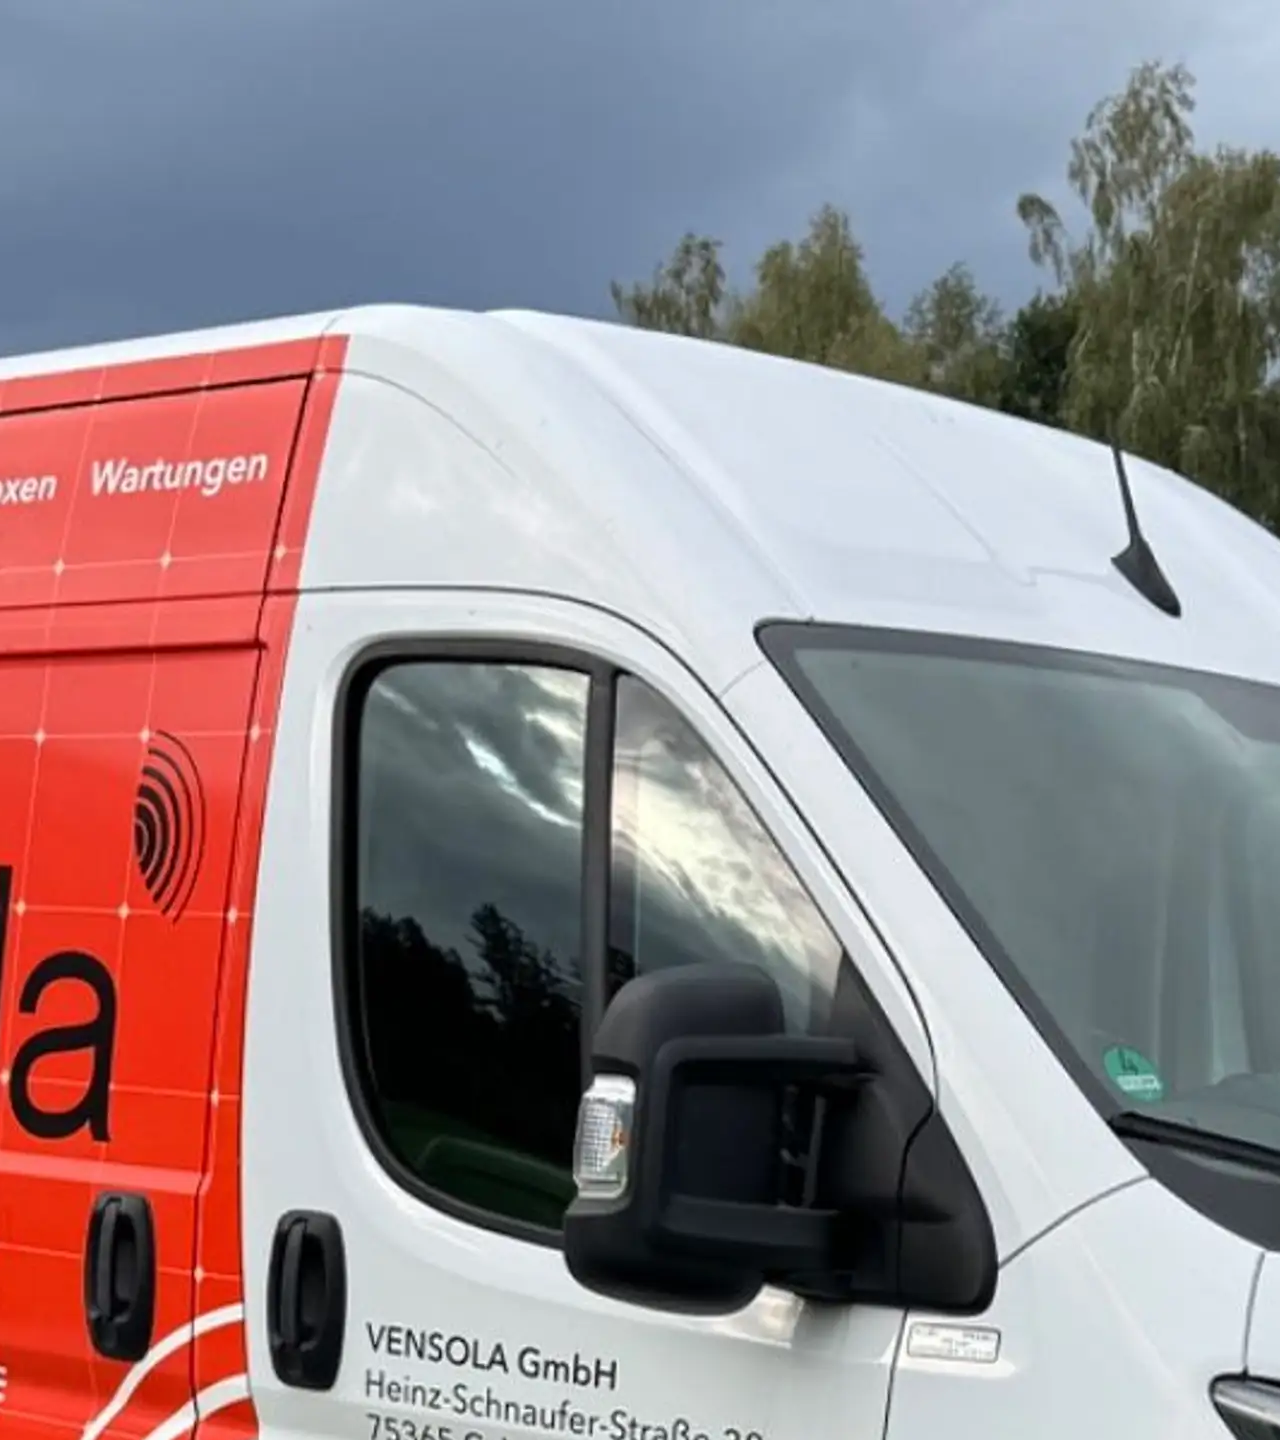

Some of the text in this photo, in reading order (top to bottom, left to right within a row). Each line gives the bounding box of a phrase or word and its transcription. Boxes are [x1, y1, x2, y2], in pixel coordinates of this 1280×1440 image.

[90, 452, 268, 496] Wartungen
[365, 1322, 618, 1391] VENSOLA GmbH
